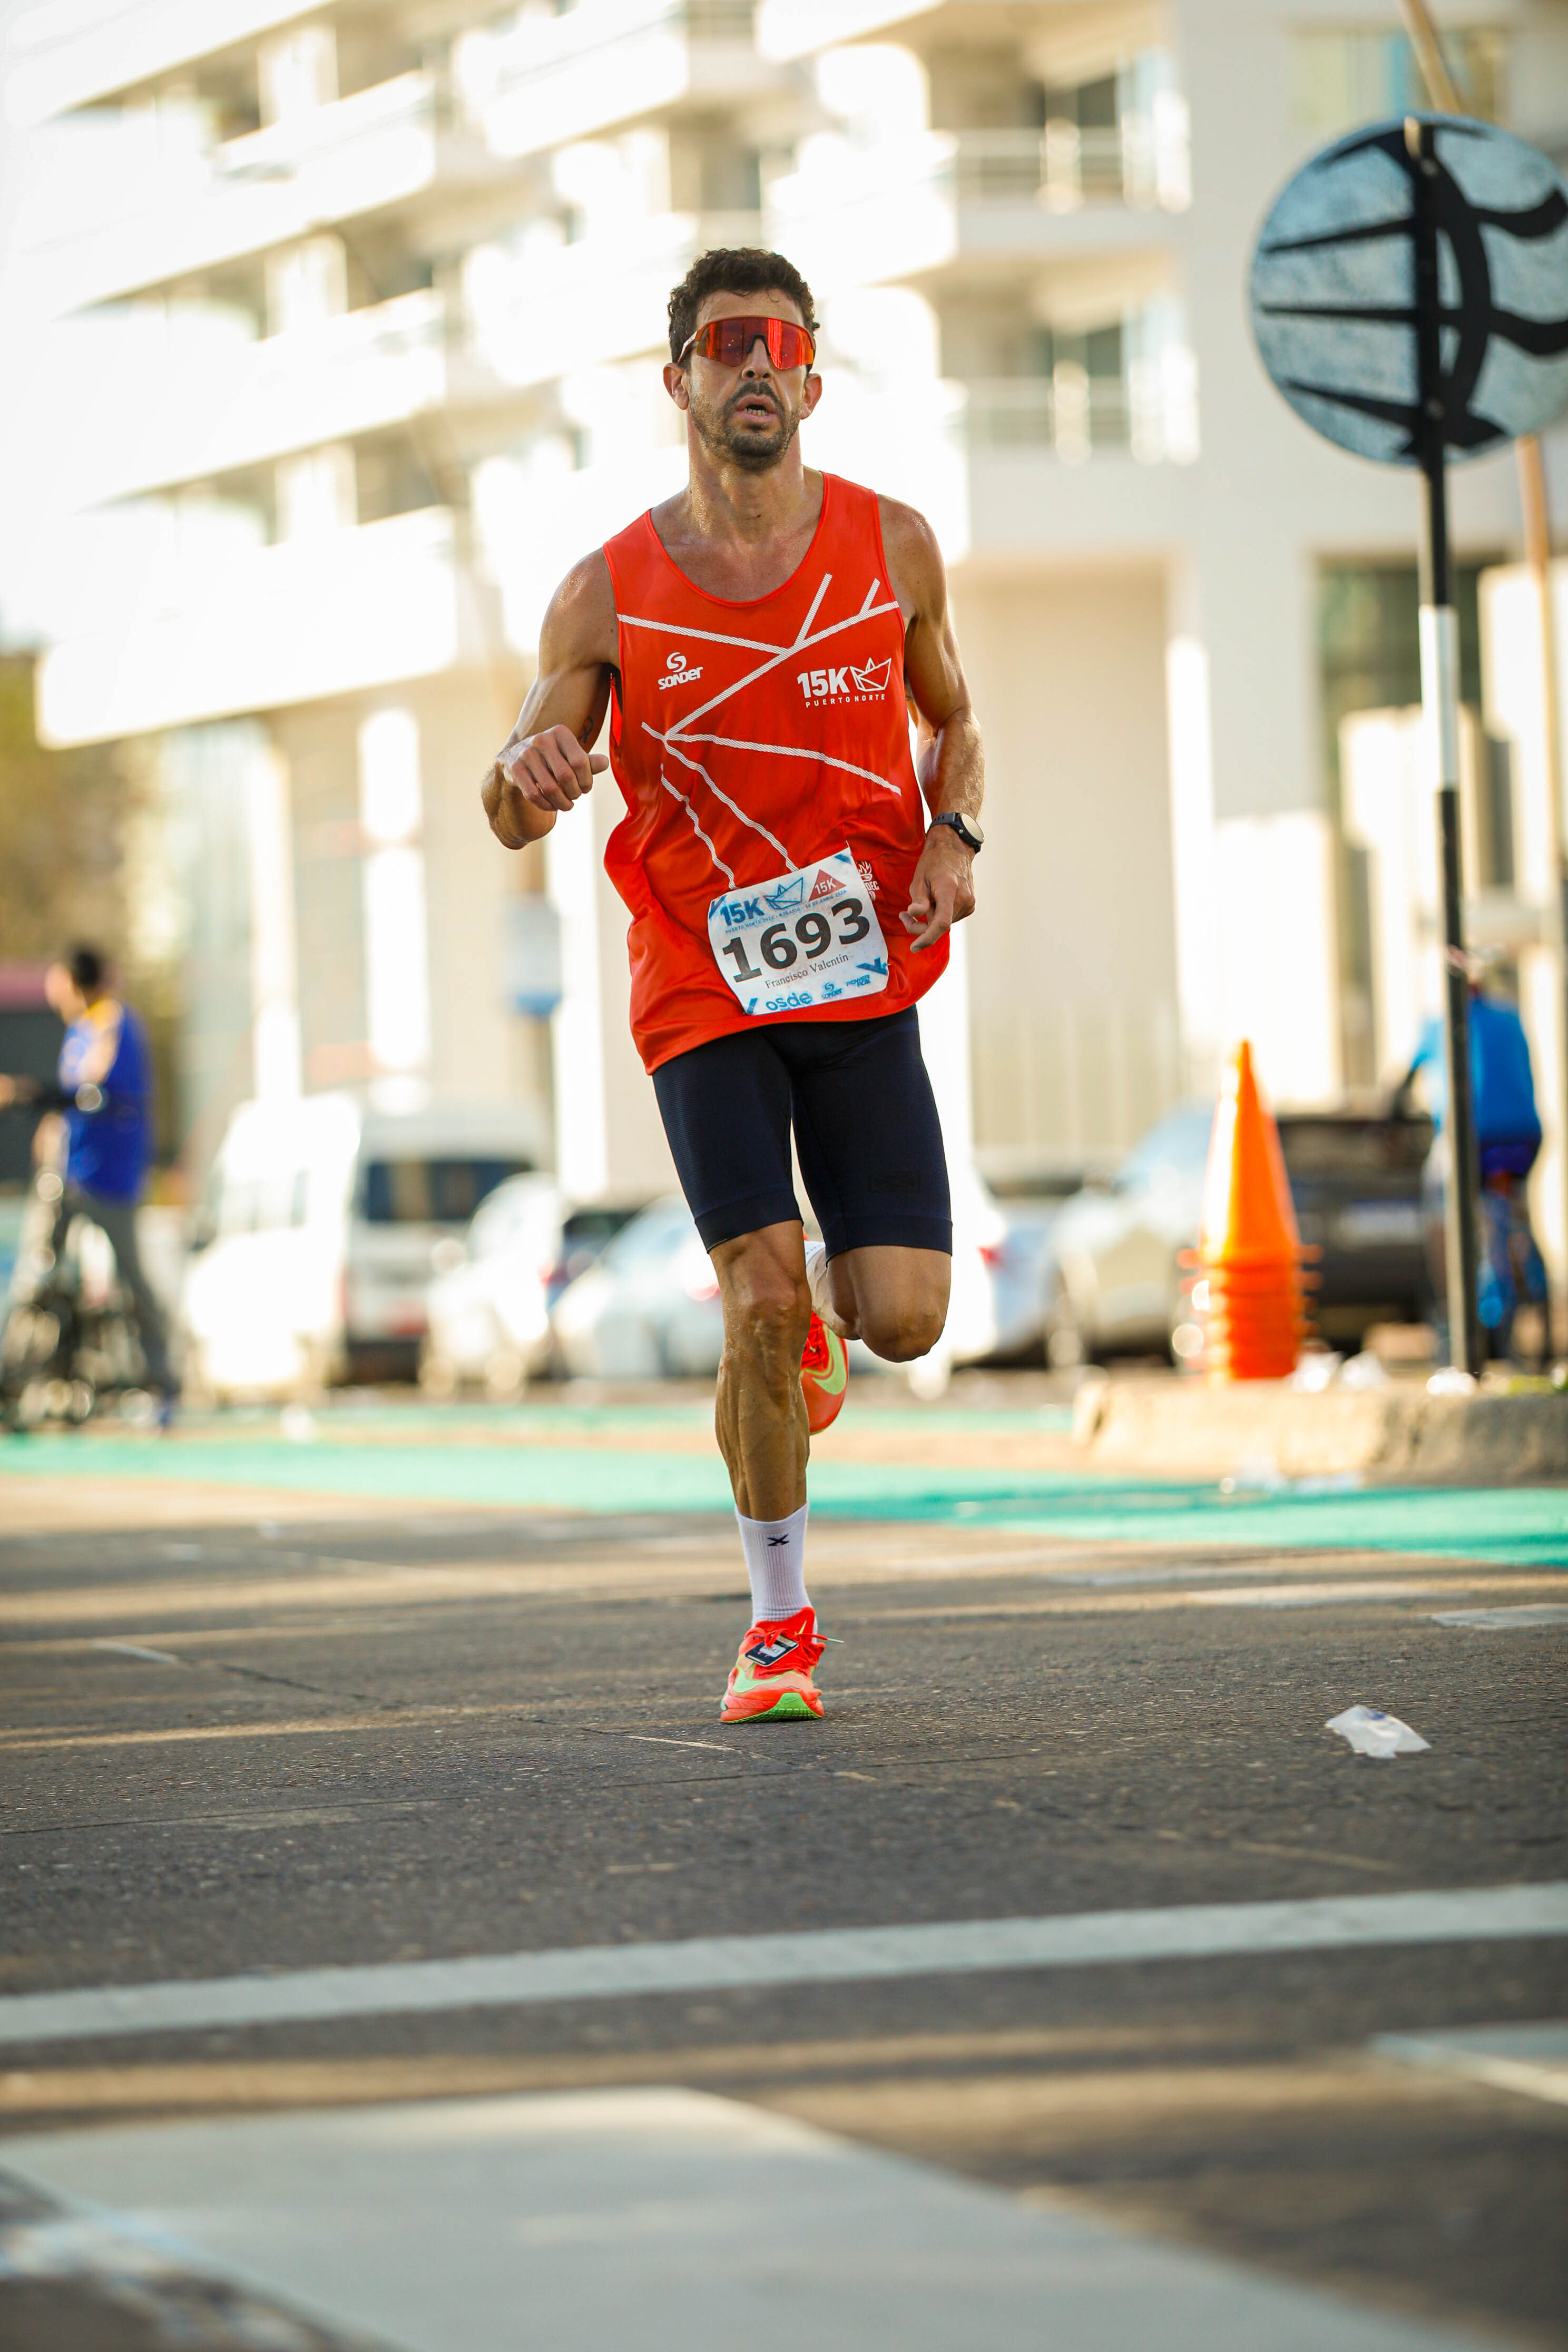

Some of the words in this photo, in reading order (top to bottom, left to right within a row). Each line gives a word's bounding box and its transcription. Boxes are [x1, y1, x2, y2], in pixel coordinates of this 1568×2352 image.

[797, 666, 850, 699] 15K
[815, 877, 836, 895] 15K
[720, 896, 765, 926] 15K
[722, 898, 870, 983] 1693
[765, 969, 808, 989] Francisco
[809, 953, 849, 973] Valentín
[766, 992, 813, 1011] osde
